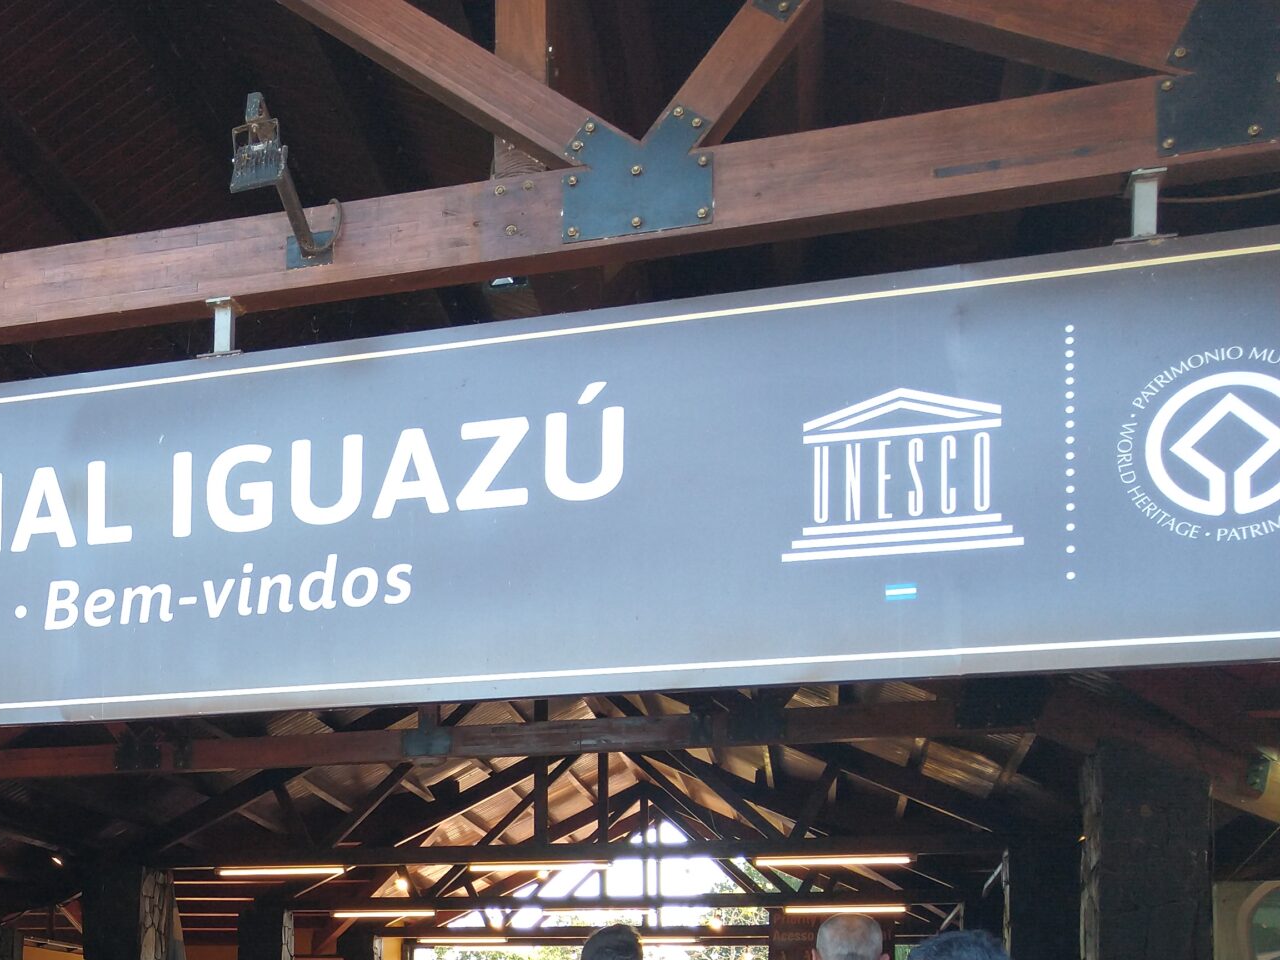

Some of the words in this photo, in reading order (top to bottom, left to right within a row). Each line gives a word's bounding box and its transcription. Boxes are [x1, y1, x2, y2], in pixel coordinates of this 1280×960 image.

[1132, 345, 1243, 409] PATRIMONIO
[171, 381, 625, 538] IGUAZÚ
[813, 431, 991, 524] UNESCO
[1116, 421, 1138, 484] WORLD
[1127, 485, 1202, 539] HERITAGE
[43, 553, 413, 631] Bem-vindos
[773, 931, 815, 941] Acesso
